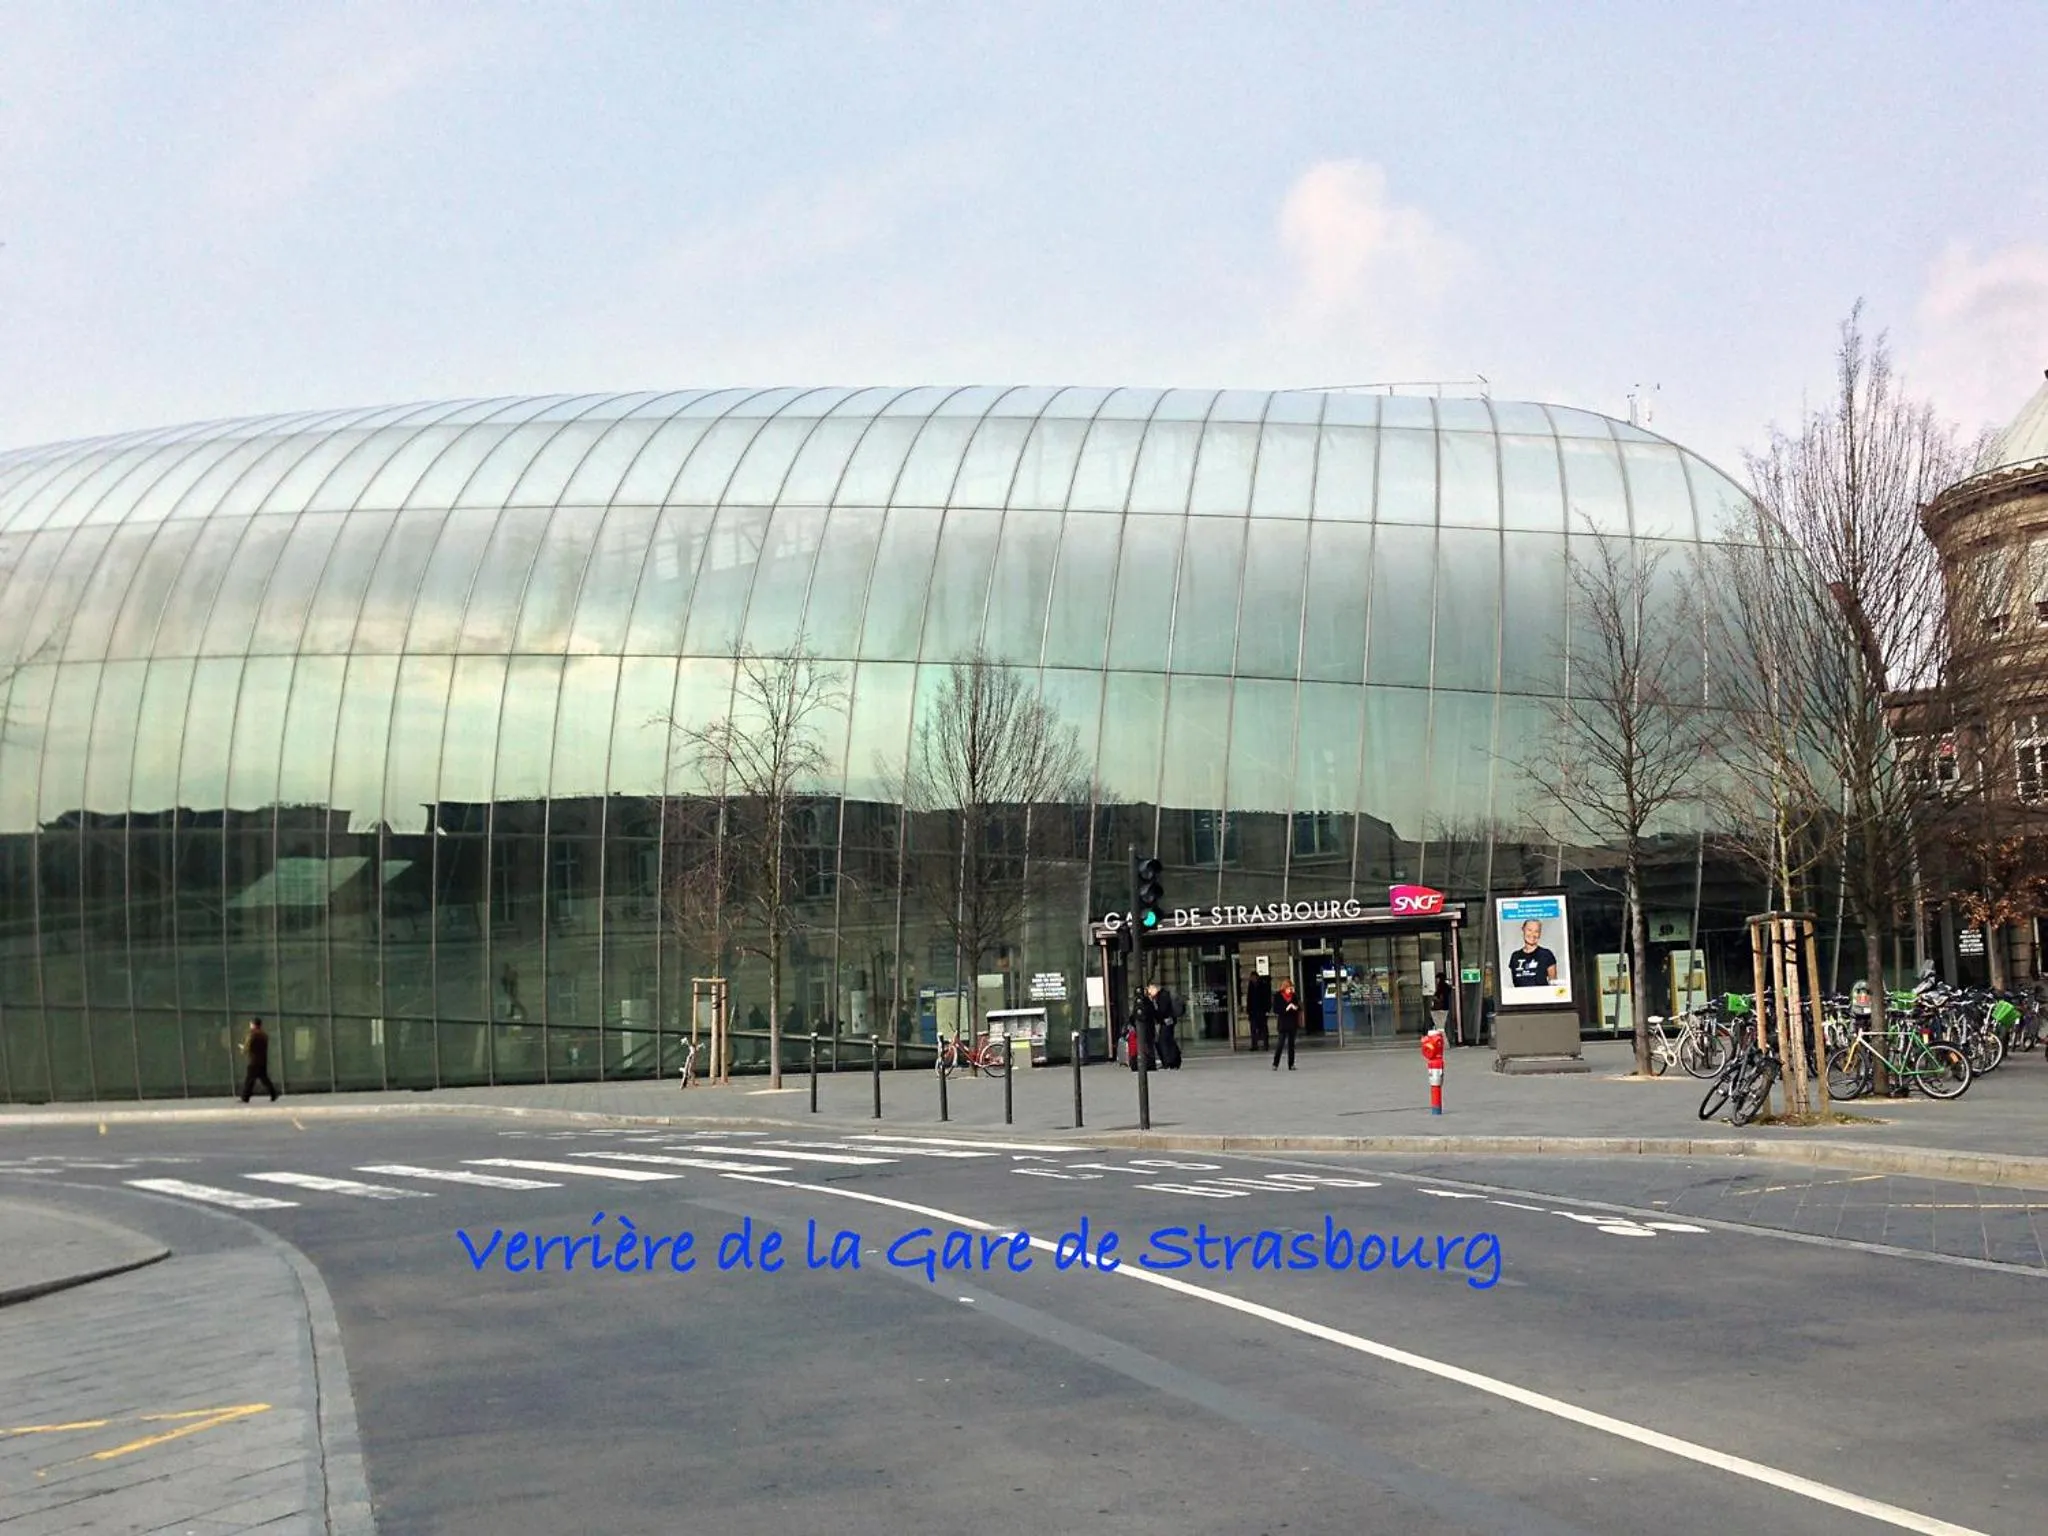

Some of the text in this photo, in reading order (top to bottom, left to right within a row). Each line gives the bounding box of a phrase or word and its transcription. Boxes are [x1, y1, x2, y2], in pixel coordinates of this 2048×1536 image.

[1104, 899, 1361, 930] GA DE STRASBOURG
[1393, 894, 1442, 912] SNCF
[1132, 1173, 1382, 1198] BUS
